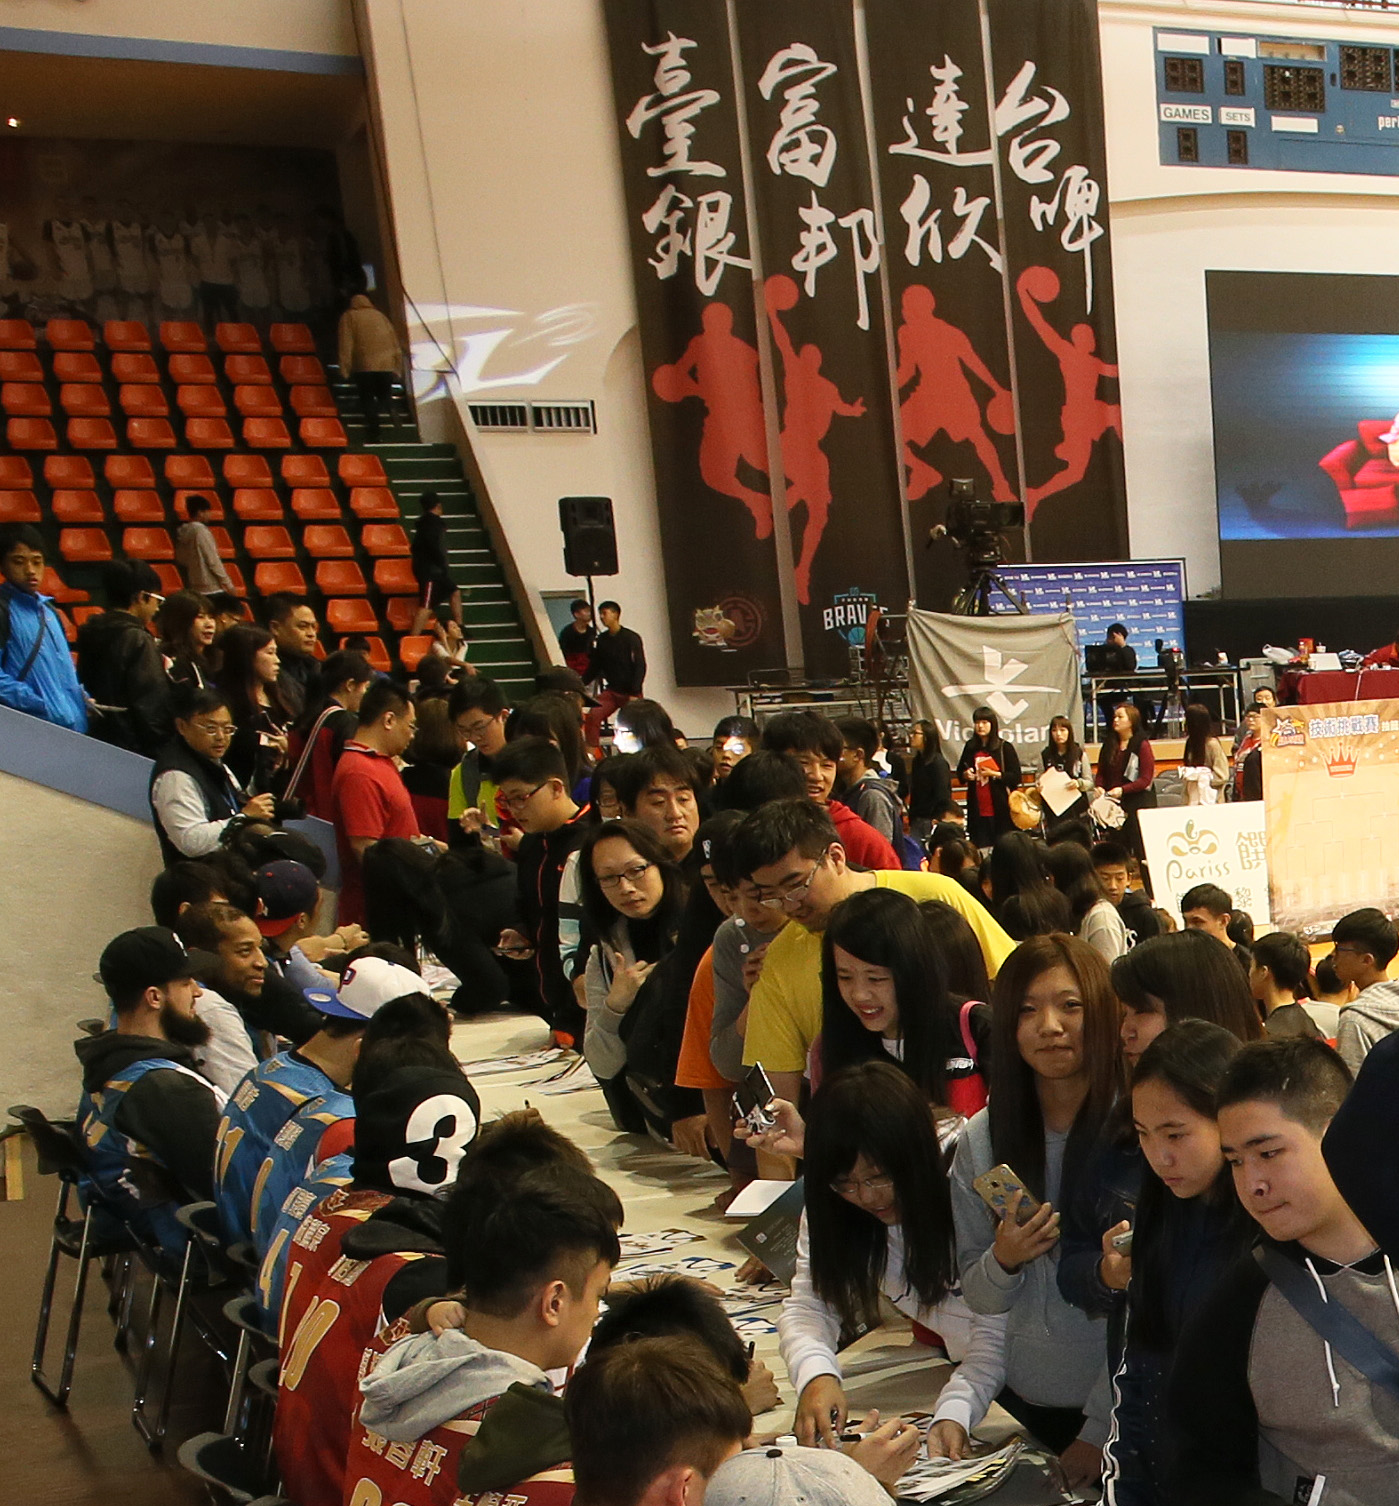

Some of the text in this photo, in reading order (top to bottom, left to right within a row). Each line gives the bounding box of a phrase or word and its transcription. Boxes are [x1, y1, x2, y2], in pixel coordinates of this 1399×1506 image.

[889, 53, 1004, 273] 達欣
[1163, 106, 1210, 120] GAMES
[1226, 111, 1251, 122] SETS
[626, 31, 760, 297] 臺銀
[758, 43, 883, 331] 富邦
[823, 604, 890, 630] BRAV
[388, 1094, 478, 1195] 3
